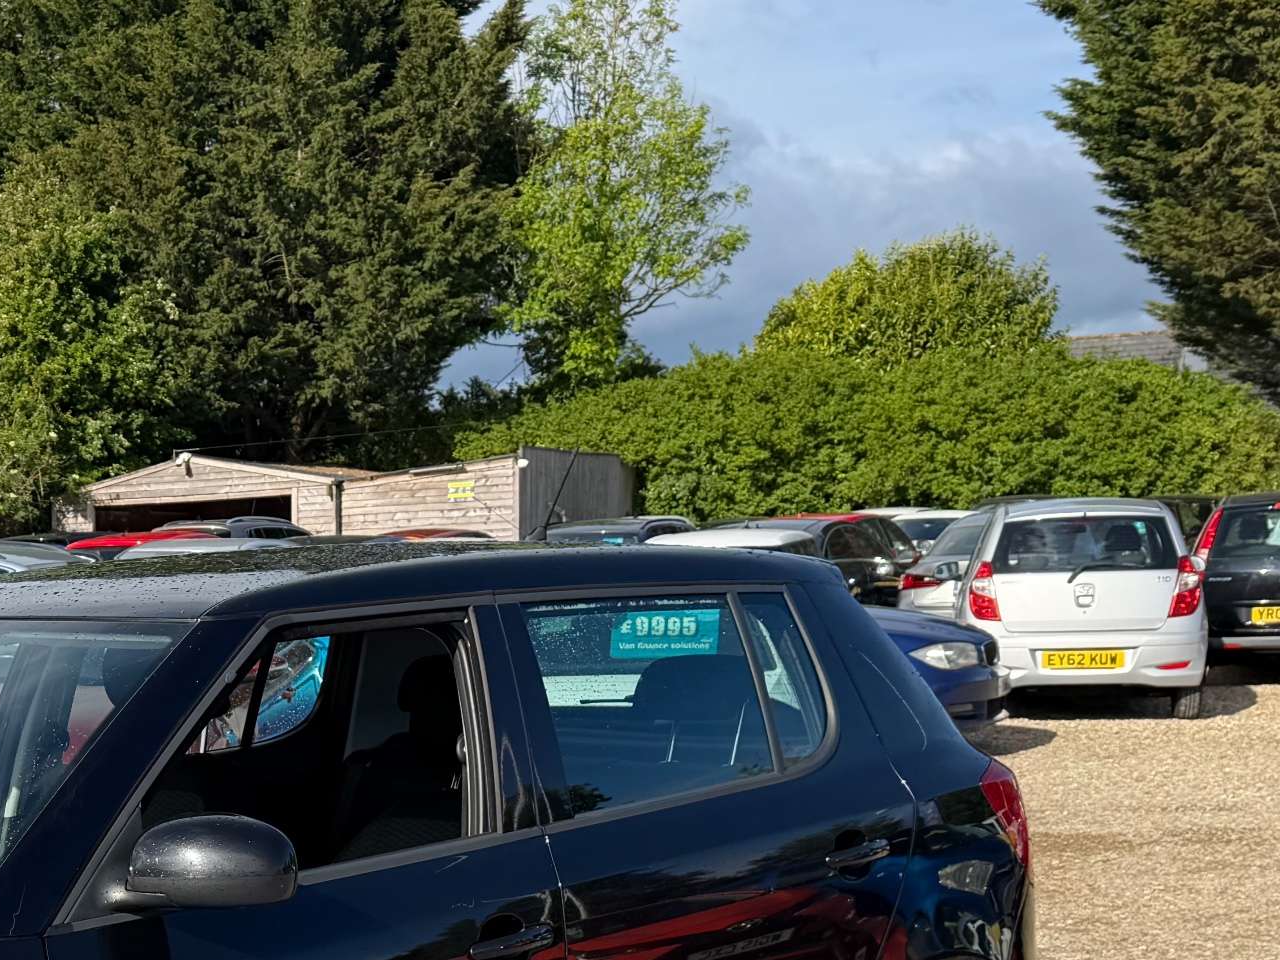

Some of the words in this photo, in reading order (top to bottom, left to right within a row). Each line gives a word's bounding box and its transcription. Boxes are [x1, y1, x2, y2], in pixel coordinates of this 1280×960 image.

[620, 616, 696, 636] £9995
[618, 642, 635, 650] Van
[637, 641, 668, 649] finance
[670, 641, 710, 650] solutions
[1048, 653, 1085, 666] EY62
[1089, 652, 1118, 666] KUW
